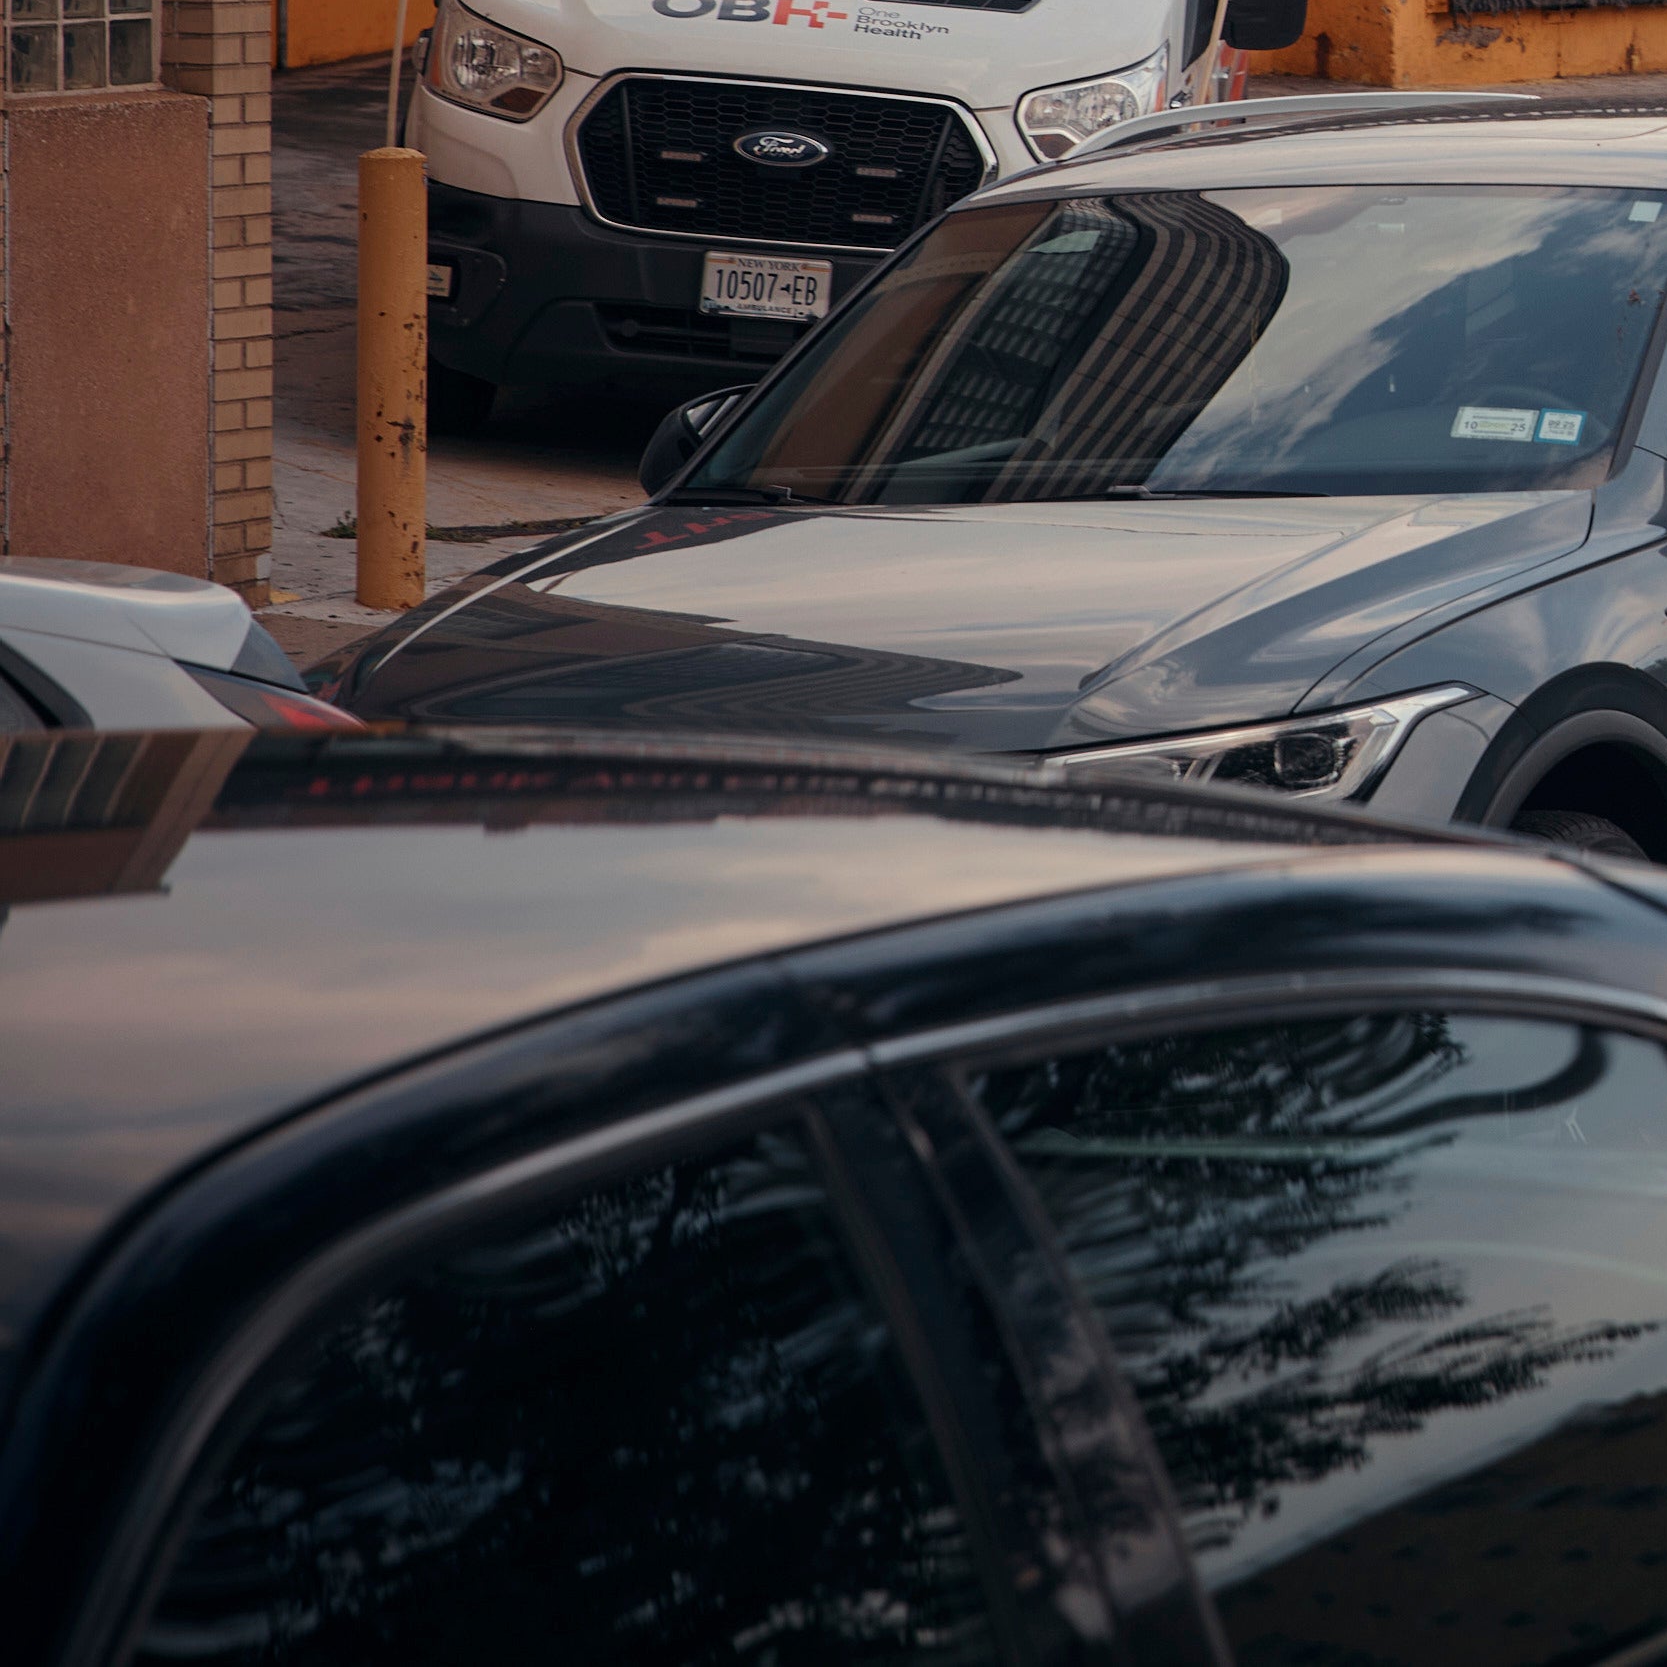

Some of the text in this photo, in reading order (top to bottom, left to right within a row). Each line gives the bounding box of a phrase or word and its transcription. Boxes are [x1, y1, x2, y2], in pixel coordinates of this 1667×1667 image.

[858, 6, 901, 18] One
[854, 23, 922, 40] Health
[856, 15, 950, 34] Brooklyn
[753, 136, 806, 156] Ford
[737, 258, 800, 272] NEW YORK
[716, 269, 778, 302] 10507
